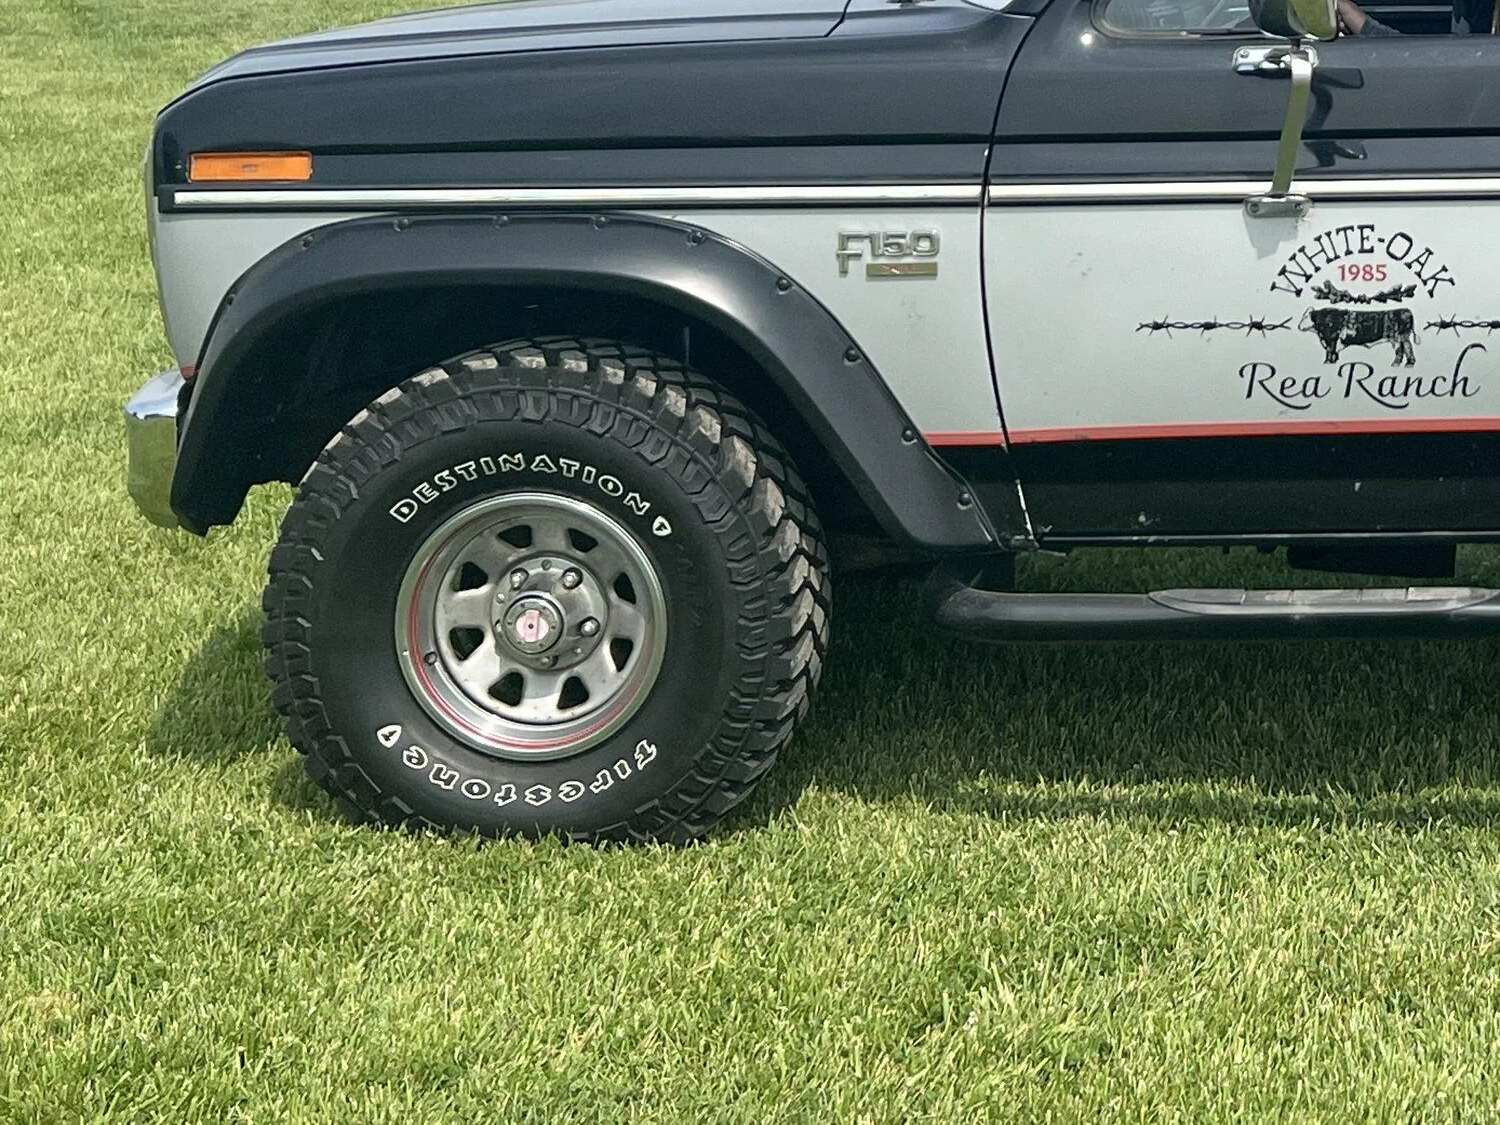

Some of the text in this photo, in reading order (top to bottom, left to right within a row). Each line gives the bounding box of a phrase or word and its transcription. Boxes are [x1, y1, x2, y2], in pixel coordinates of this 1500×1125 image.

[1337, 263, 1388, 282] 1985
[1238, 342, 1488, 410] Rea Ranch
[389, 452, 651, 523] DESTINATION
